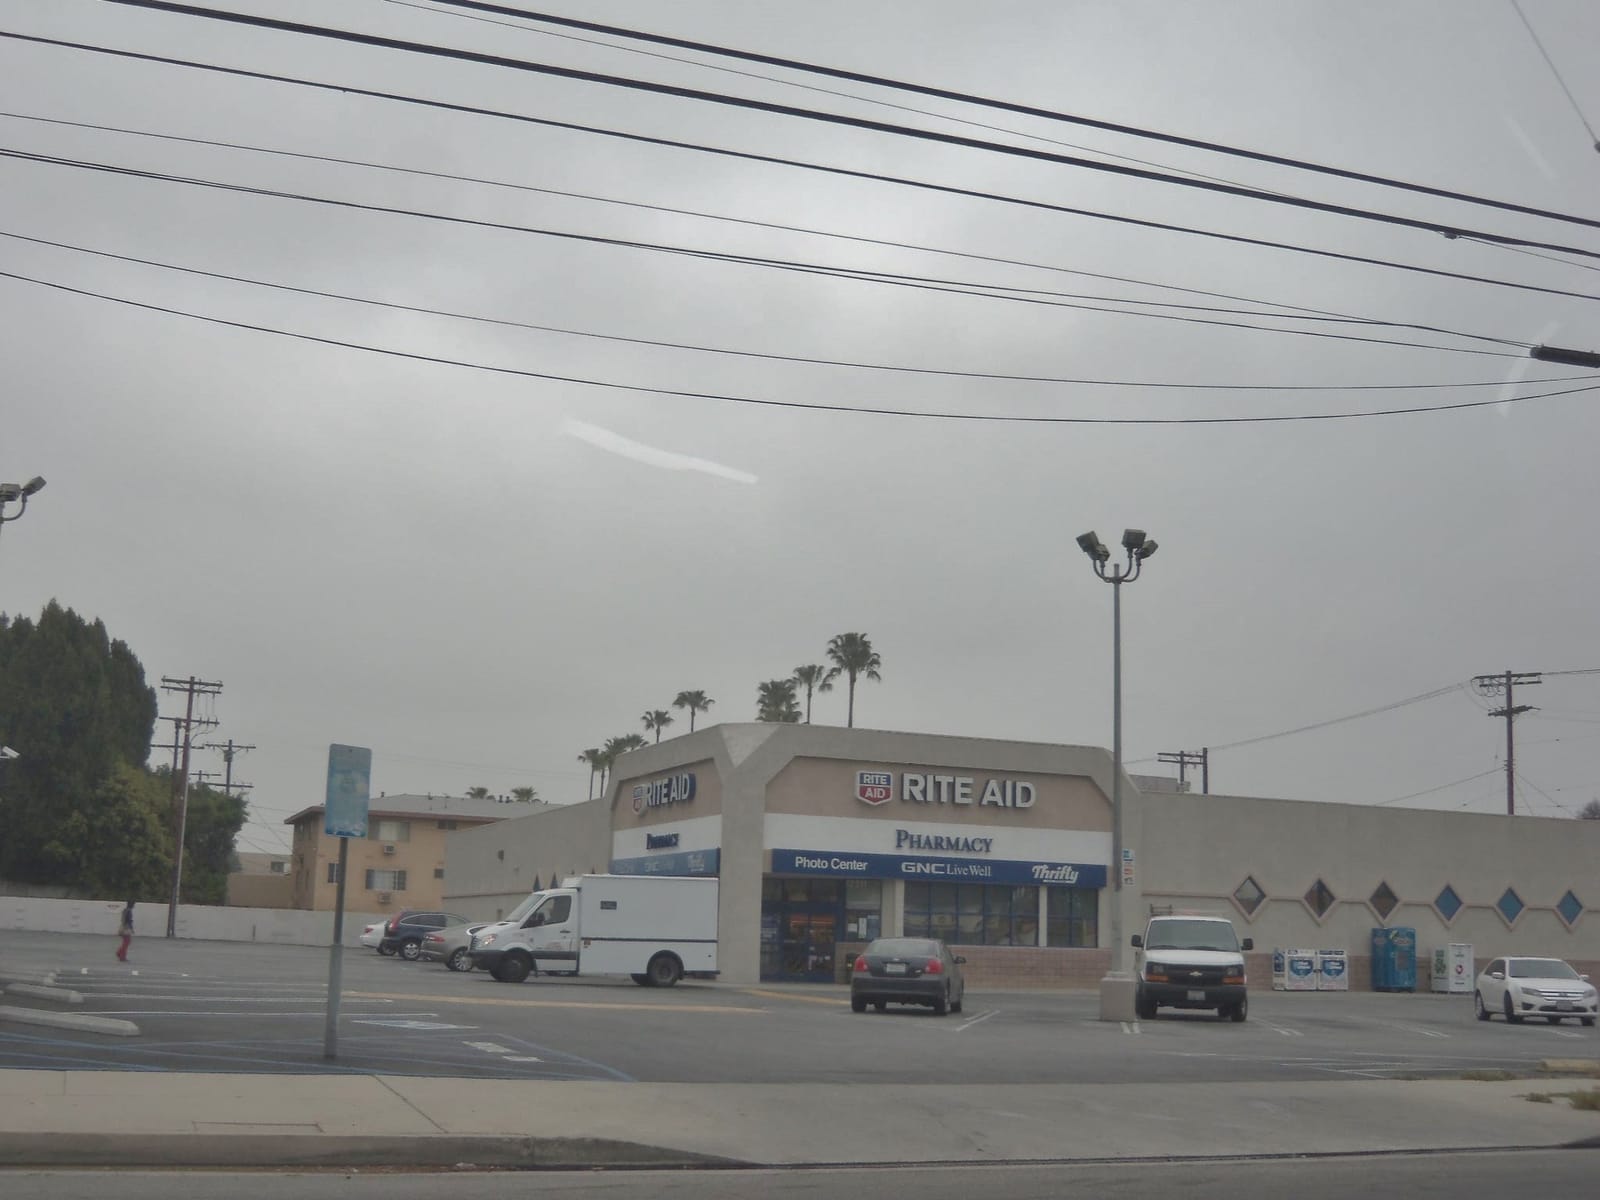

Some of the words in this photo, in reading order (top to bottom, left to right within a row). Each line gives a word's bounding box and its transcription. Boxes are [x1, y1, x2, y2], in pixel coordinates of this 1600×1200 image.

[863, 773, 888, 785] RITE
[646, 778, 669, 807] RITE
[670, 773, 691, 801] AID
[864, 787, 886, 799] AID
[902, 772, 974, 805] RITE
[980, 779, 1037, 809] AID
[895, 829, 993, 853] PHARMACY
[795, 856, 828, 869] Photo
[831, 858, 868, 871] Center
[901, 862, 945, 874] GNC
[1031, 864, 1079, 884] Thrifty
